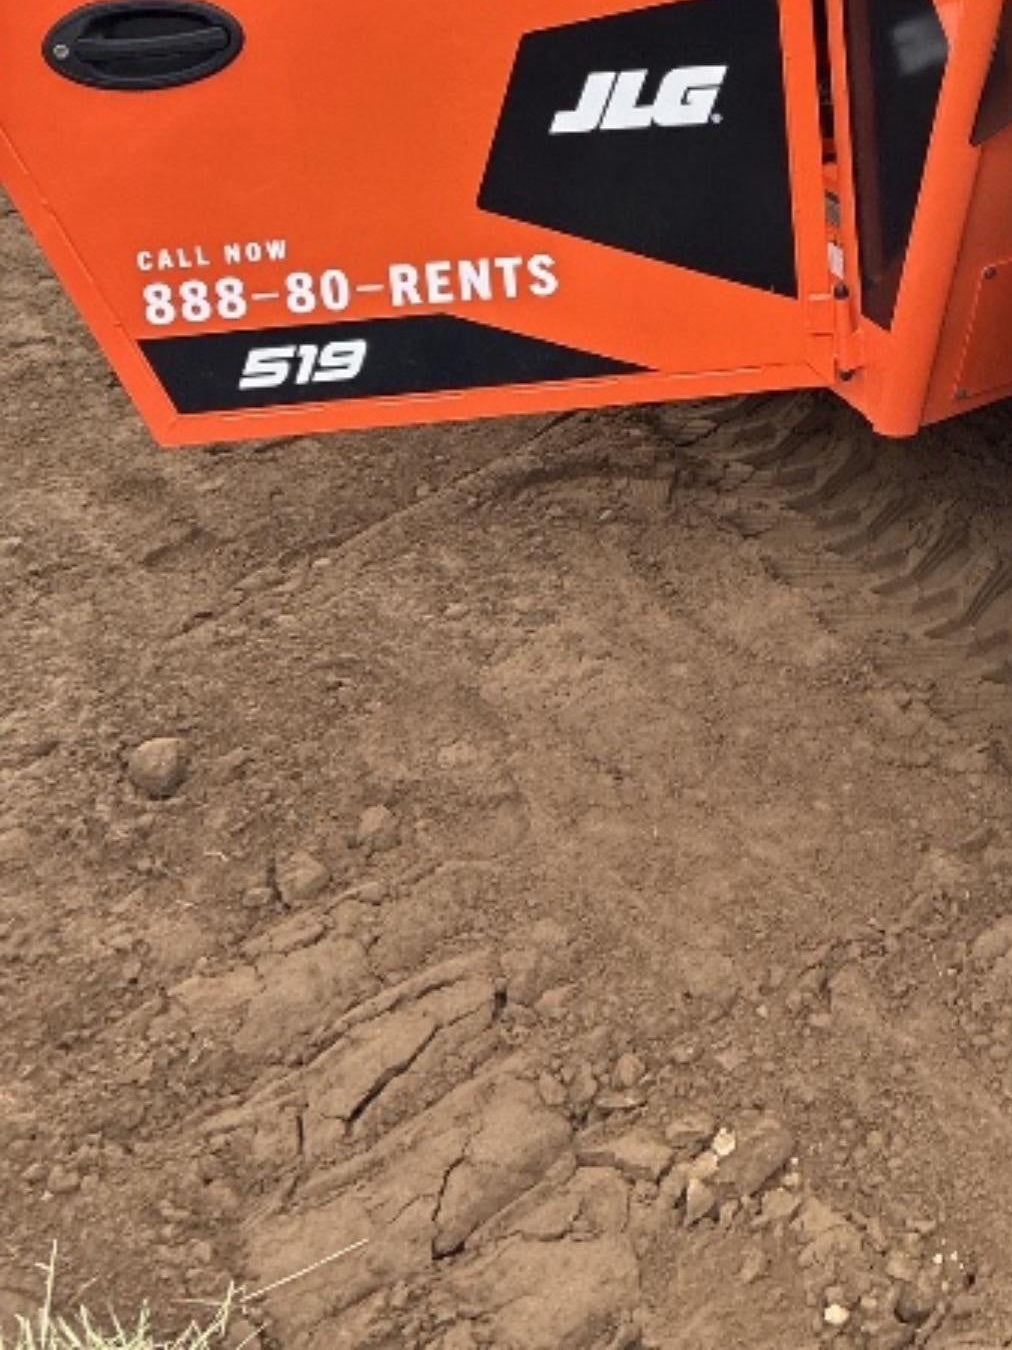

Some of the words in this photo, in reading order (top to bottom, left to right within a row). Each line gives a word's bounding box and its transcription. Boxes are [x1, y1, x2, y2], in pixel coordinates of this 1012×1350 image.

[549, 65, 728, 135] JLG
[137, 247, 211, 272] CALL
[224, 240, 287, 263] NOW
[143, 254, 559, 326] 888-80-RENTS
[238, 338, 368, 391] 519
